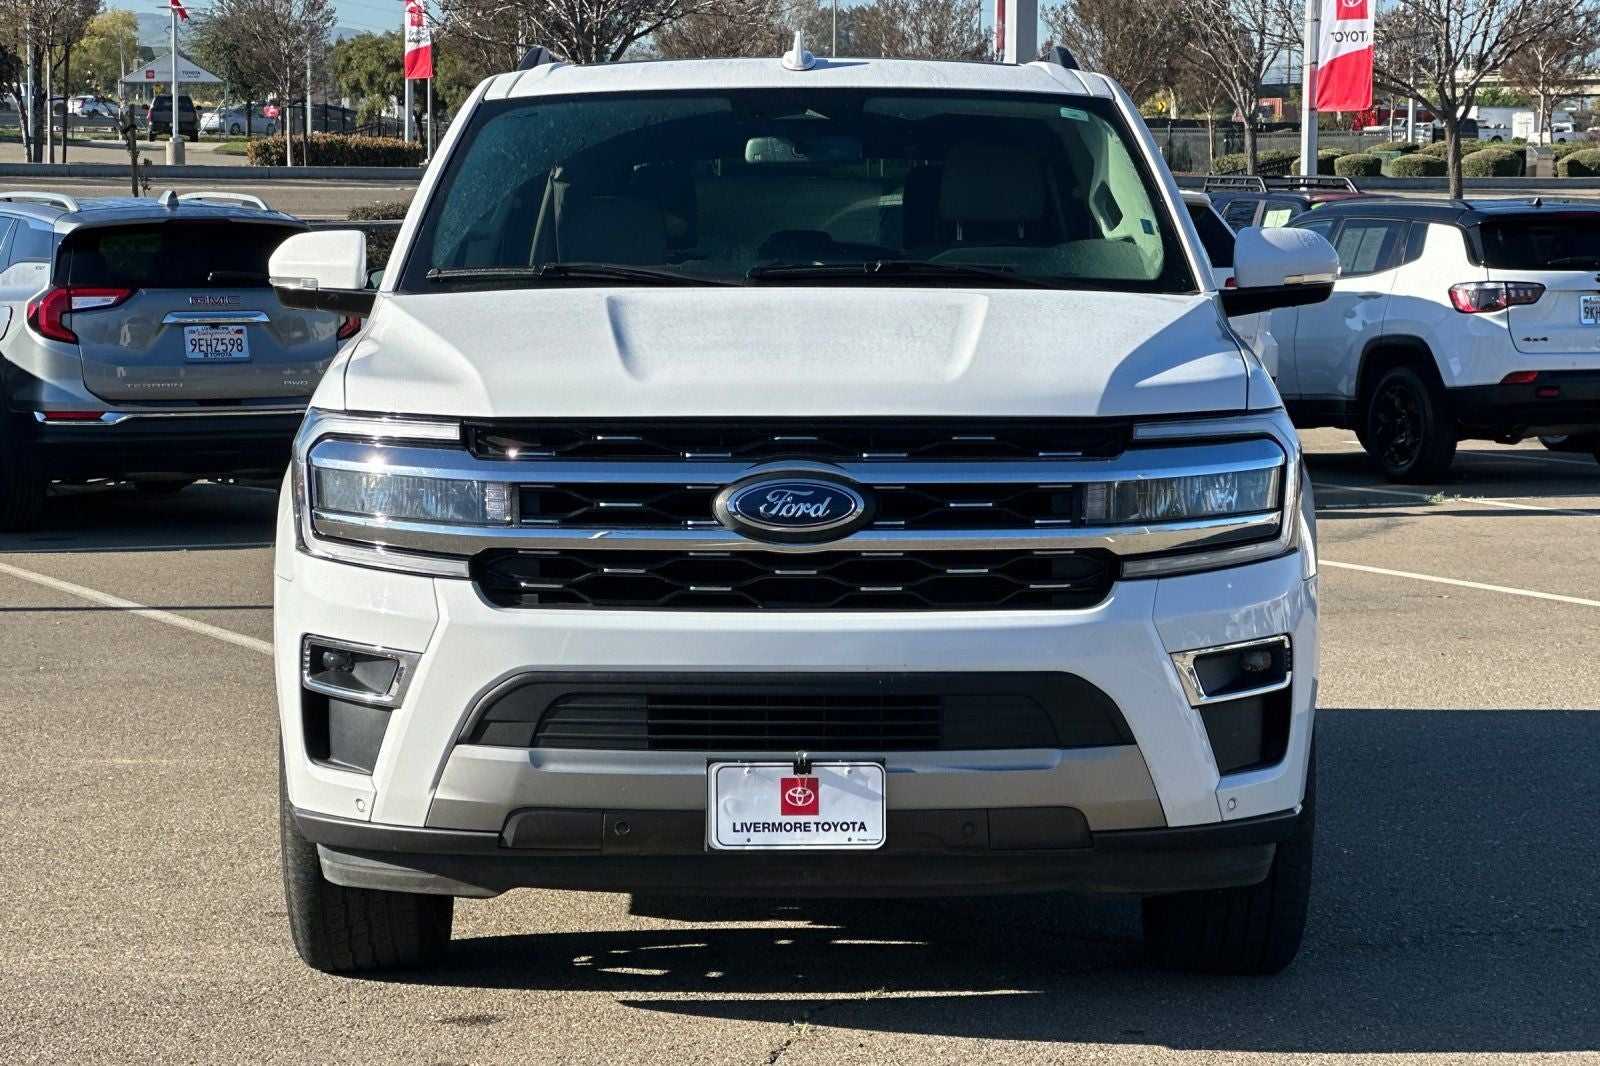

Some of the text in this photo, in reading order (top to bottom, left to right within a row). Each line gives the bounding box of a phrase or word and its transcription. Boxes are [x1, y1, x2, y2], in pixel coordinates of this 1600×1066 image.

[189, 295, 242, 306] GMC
[190, 338, 243, 353] 9EHZ598
[759, 489, 832, 519] Ford
[732, 821, 868, 833] LIVERMORE TOYOTA
